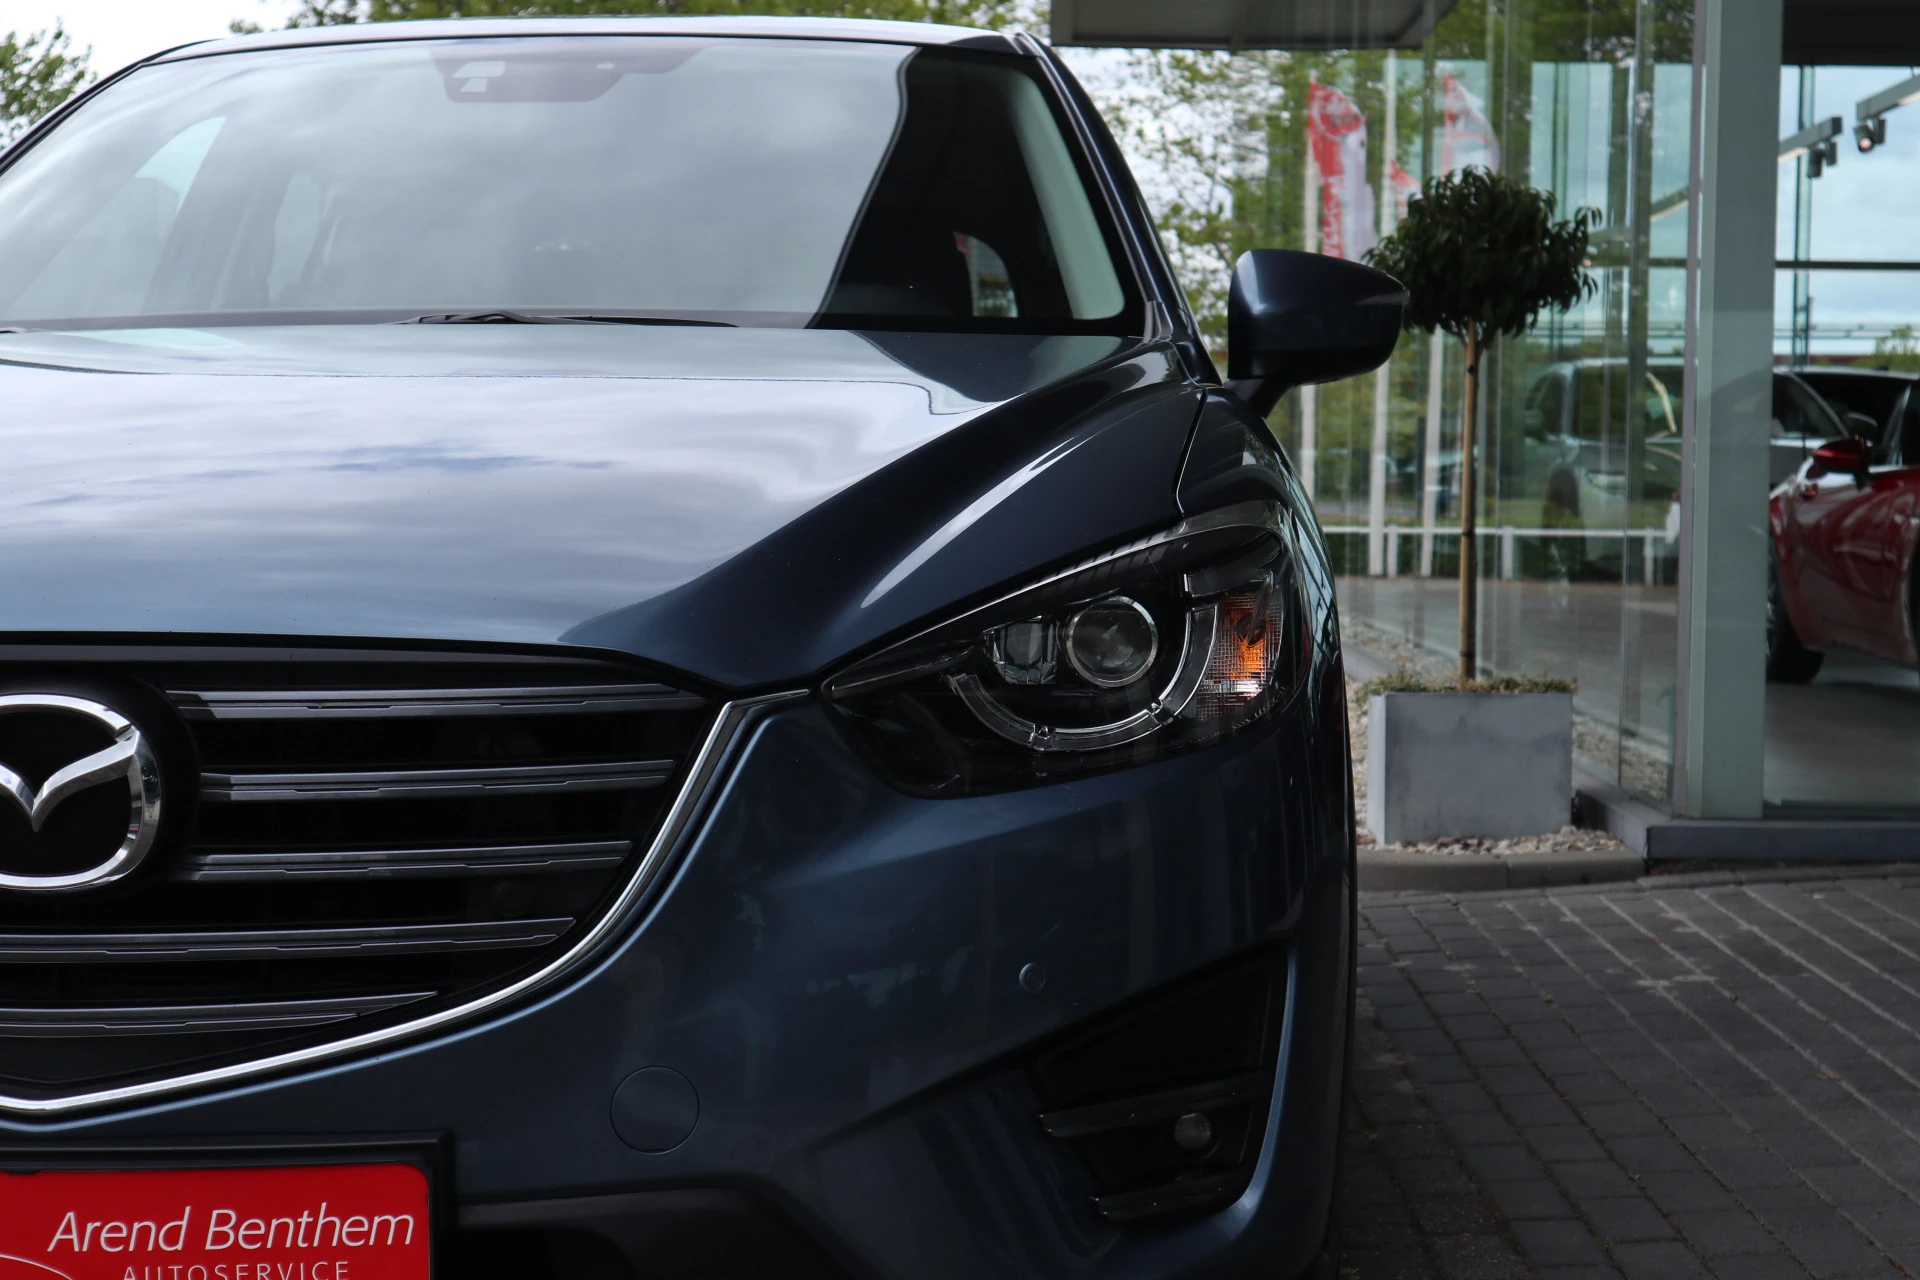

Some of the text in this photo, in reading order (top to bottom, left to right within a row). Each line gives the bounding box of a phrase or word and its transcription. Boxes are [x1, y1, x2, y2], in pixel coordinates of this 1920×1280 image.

[47, 1202, 414, 1253] Arend Benthem
[123, 1261, 349, 1280] AUTOSERVICE
